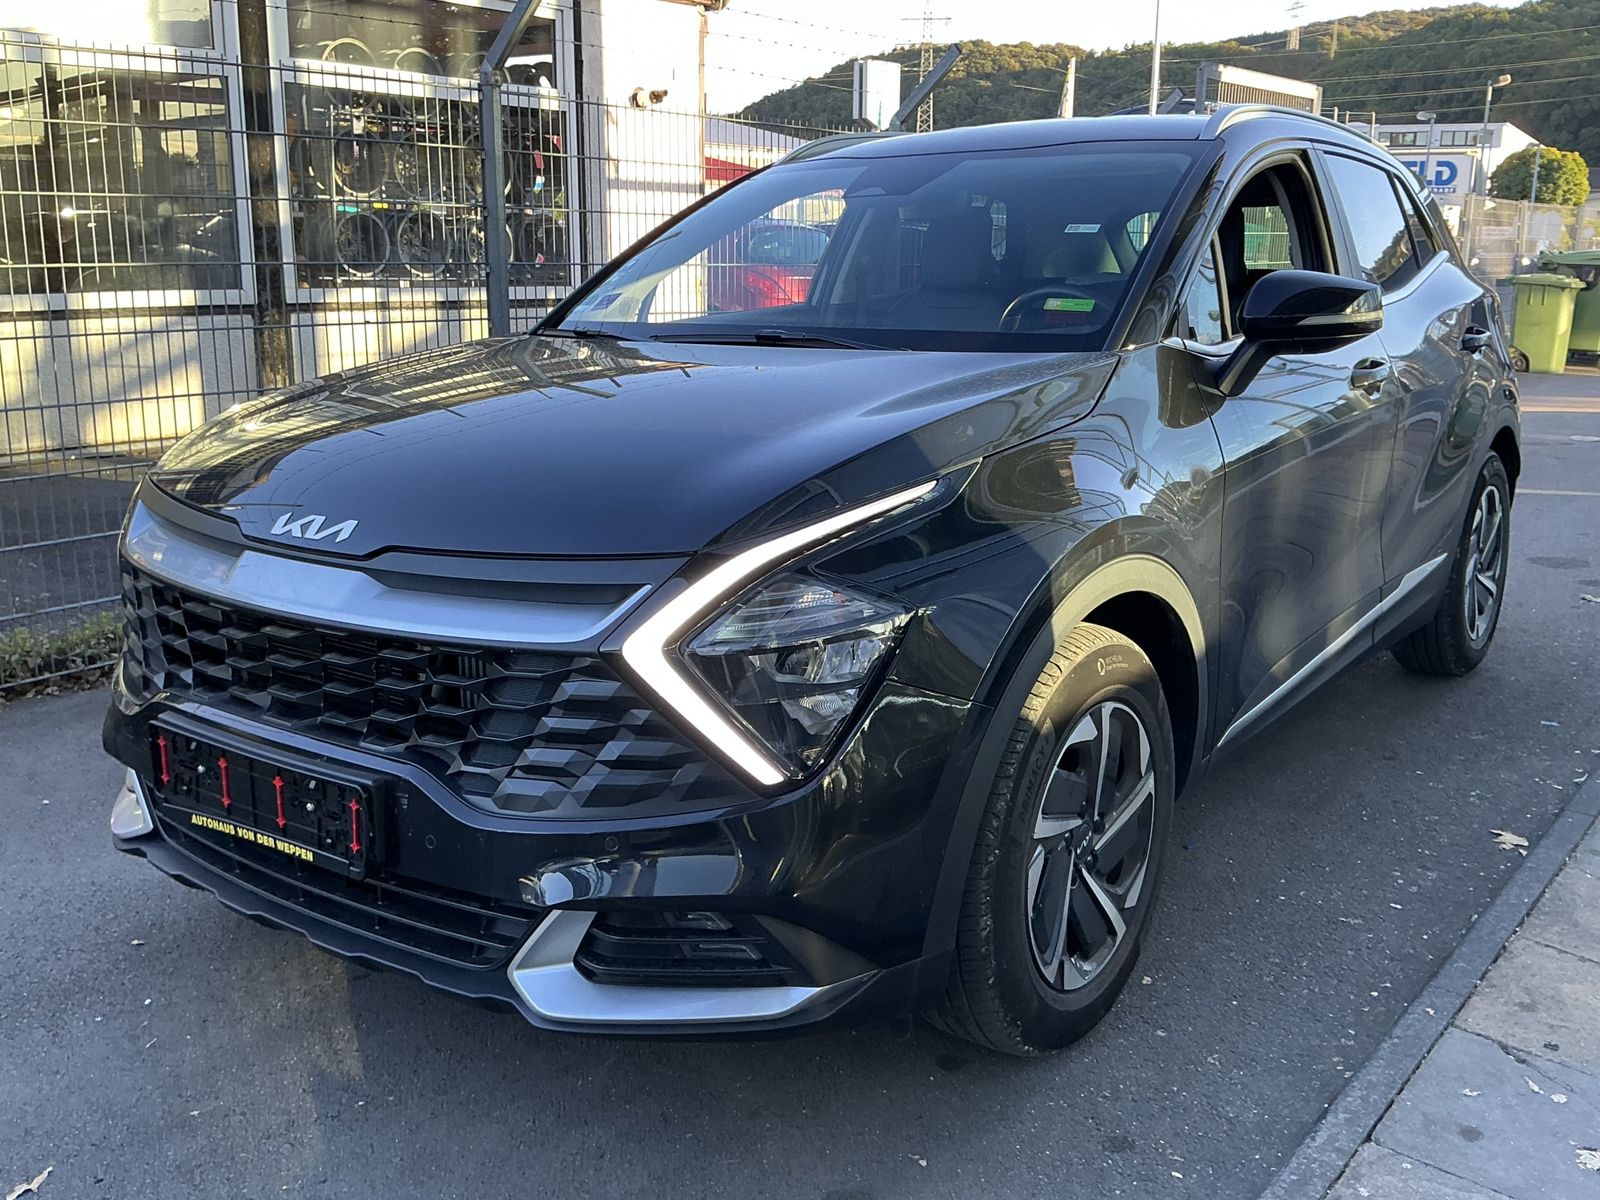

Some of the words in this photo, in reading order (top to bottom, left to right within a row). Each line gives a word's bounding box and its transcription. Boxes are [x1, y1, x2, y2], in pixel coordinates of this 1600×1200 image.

[270, 511, 358, 542] KIA
[191, 814, 236, 835] AUTOHAUS
[237, 827, 255, 841] VON
[256, 833, 275, 848] DER
[276, 839, 313, 862] WEPPEN
